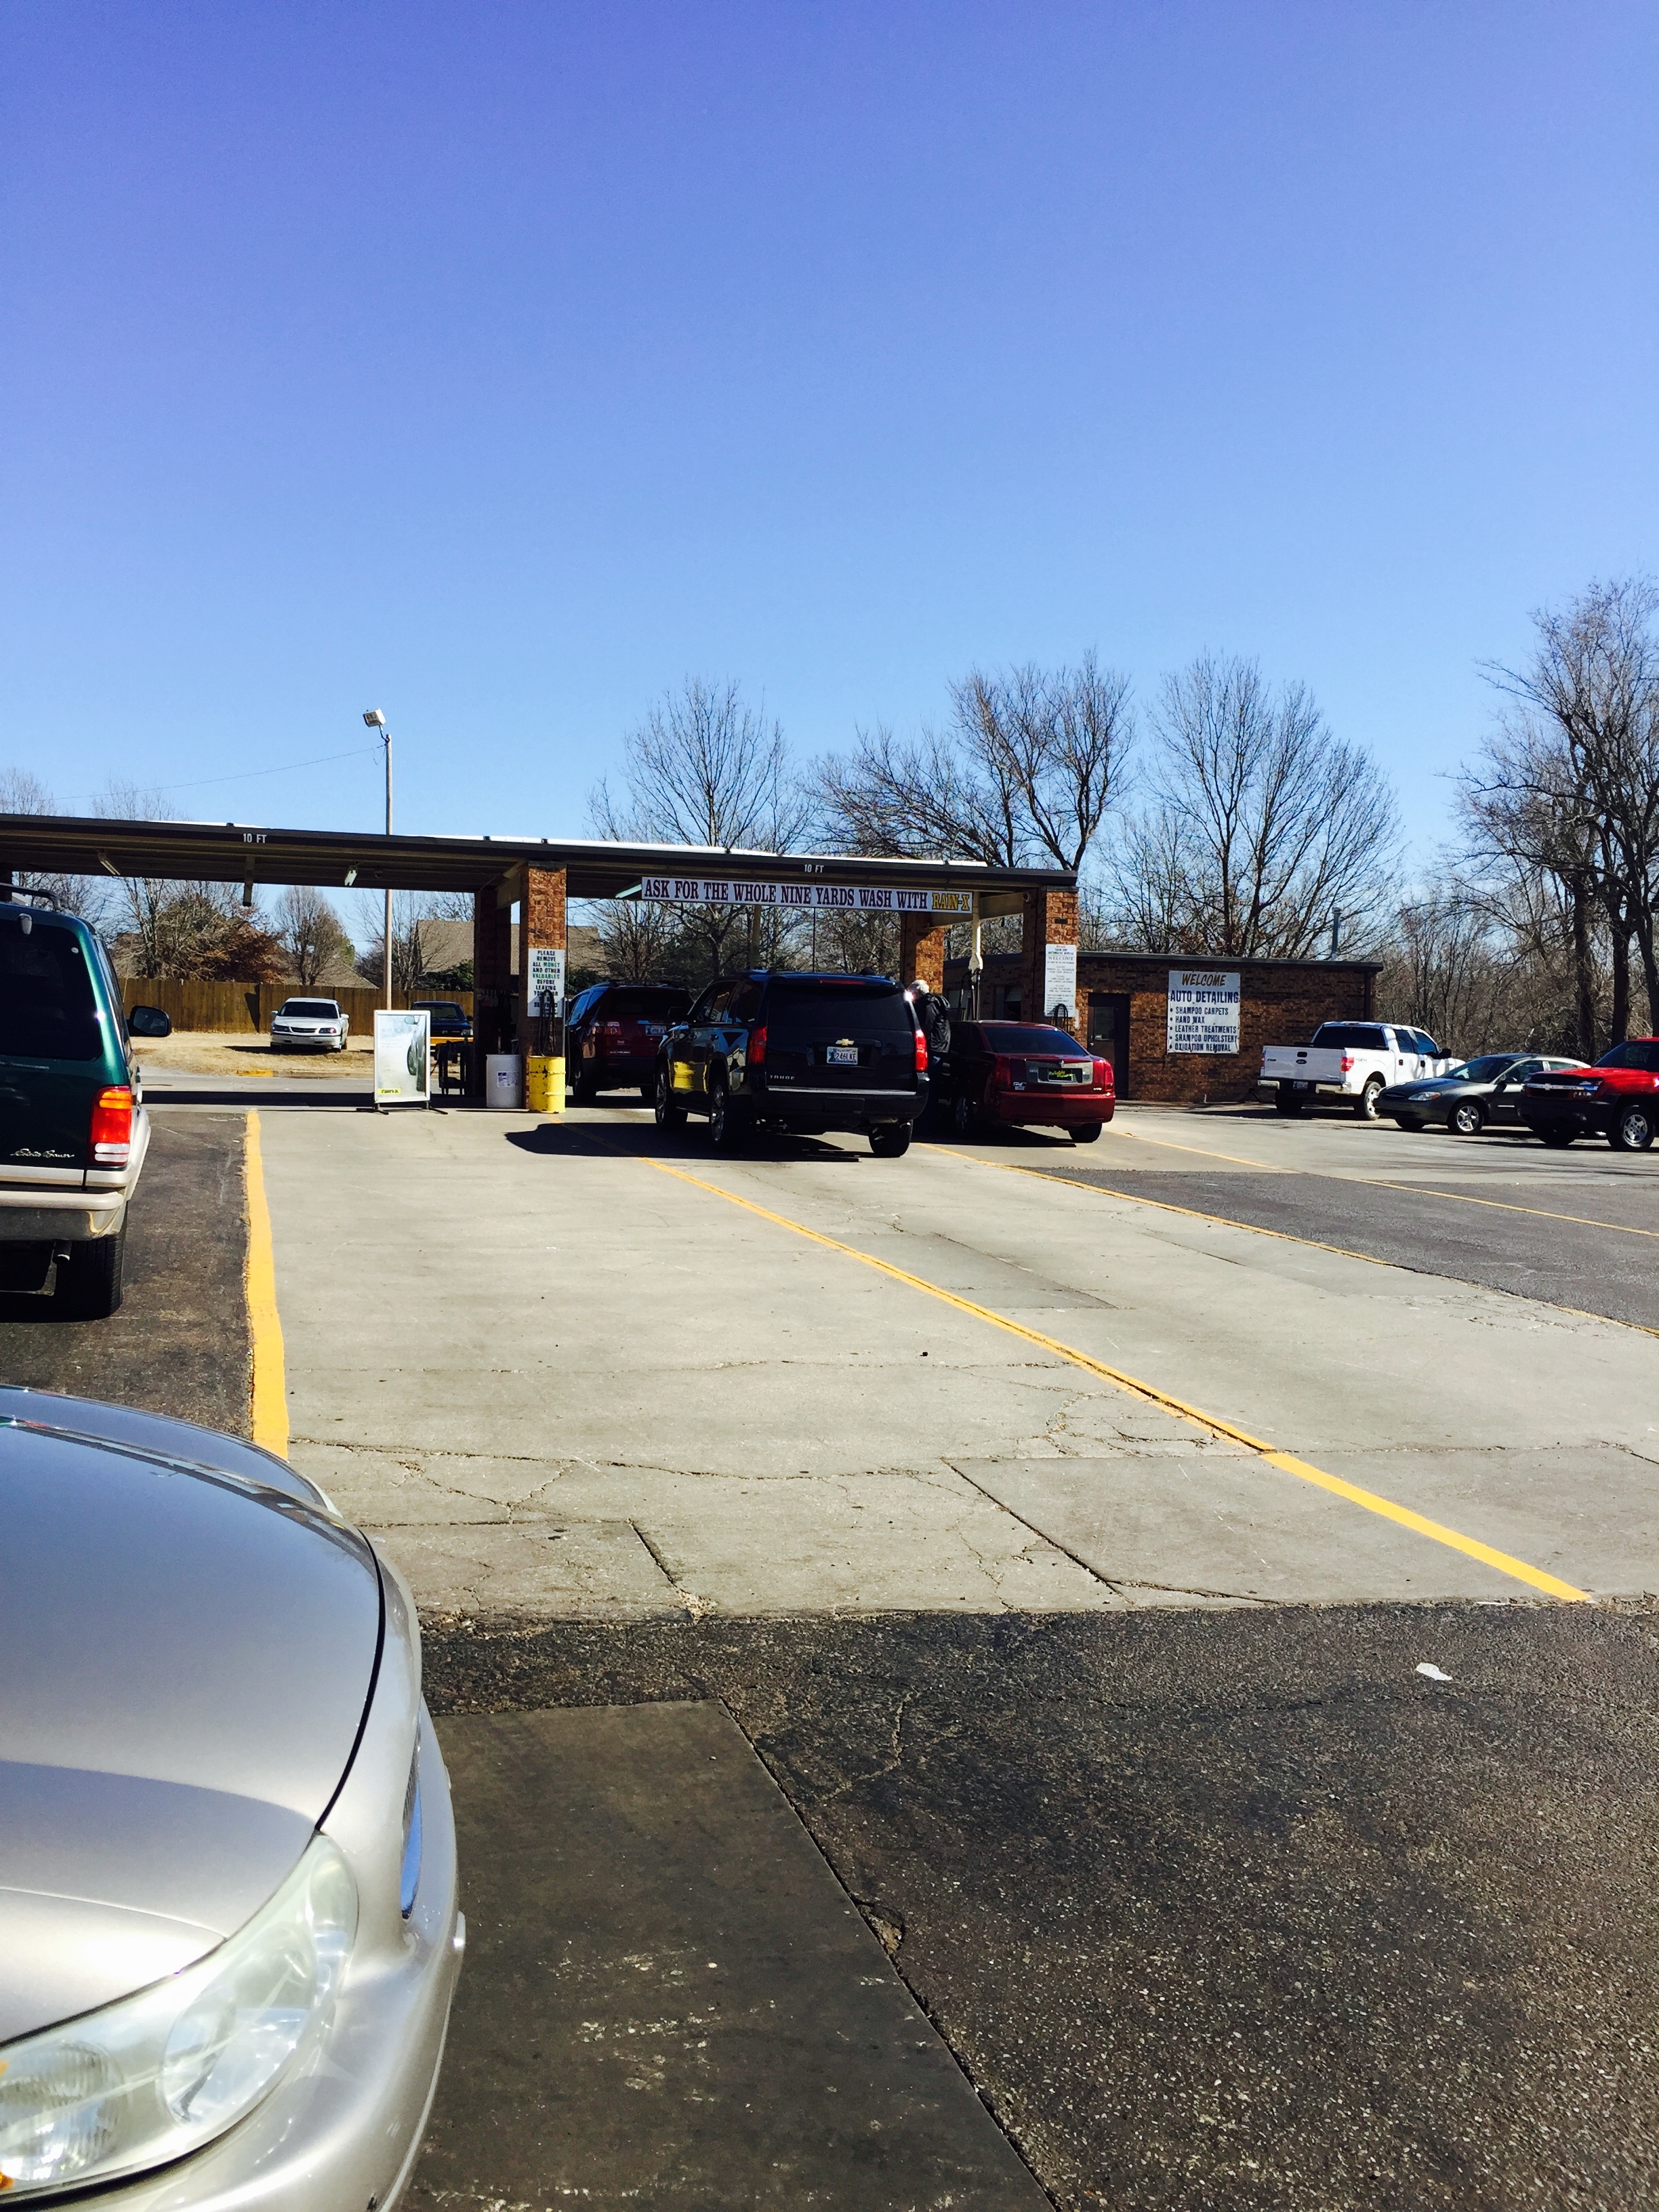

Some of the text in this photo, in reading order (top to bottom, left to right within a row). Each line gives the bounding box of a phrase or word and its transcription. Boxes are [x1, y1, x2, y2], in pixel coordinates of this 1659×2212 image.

[243, 833, 267, 844] 10 FT
[804, 863, 824, 874] 10 FT
[644, 879, 970, 911] ASK FOR THE WHOLE NINE YARDS WASH WITH RAIN-X
[1181, 973, 1227, 987] WELCOME
[1170, 990, 1239, 1004] AUTO DETAILING
[1175, 1006, 1229, 1015] SHAMPOO CARPETS
[1201, 1025, 1237, 1033] TREATMENTS
[1174, 1034, 1237, 1043] SHAMPOO UPHOLSTERY
[1174, 1043, 1204, 1051] OXIDATION
